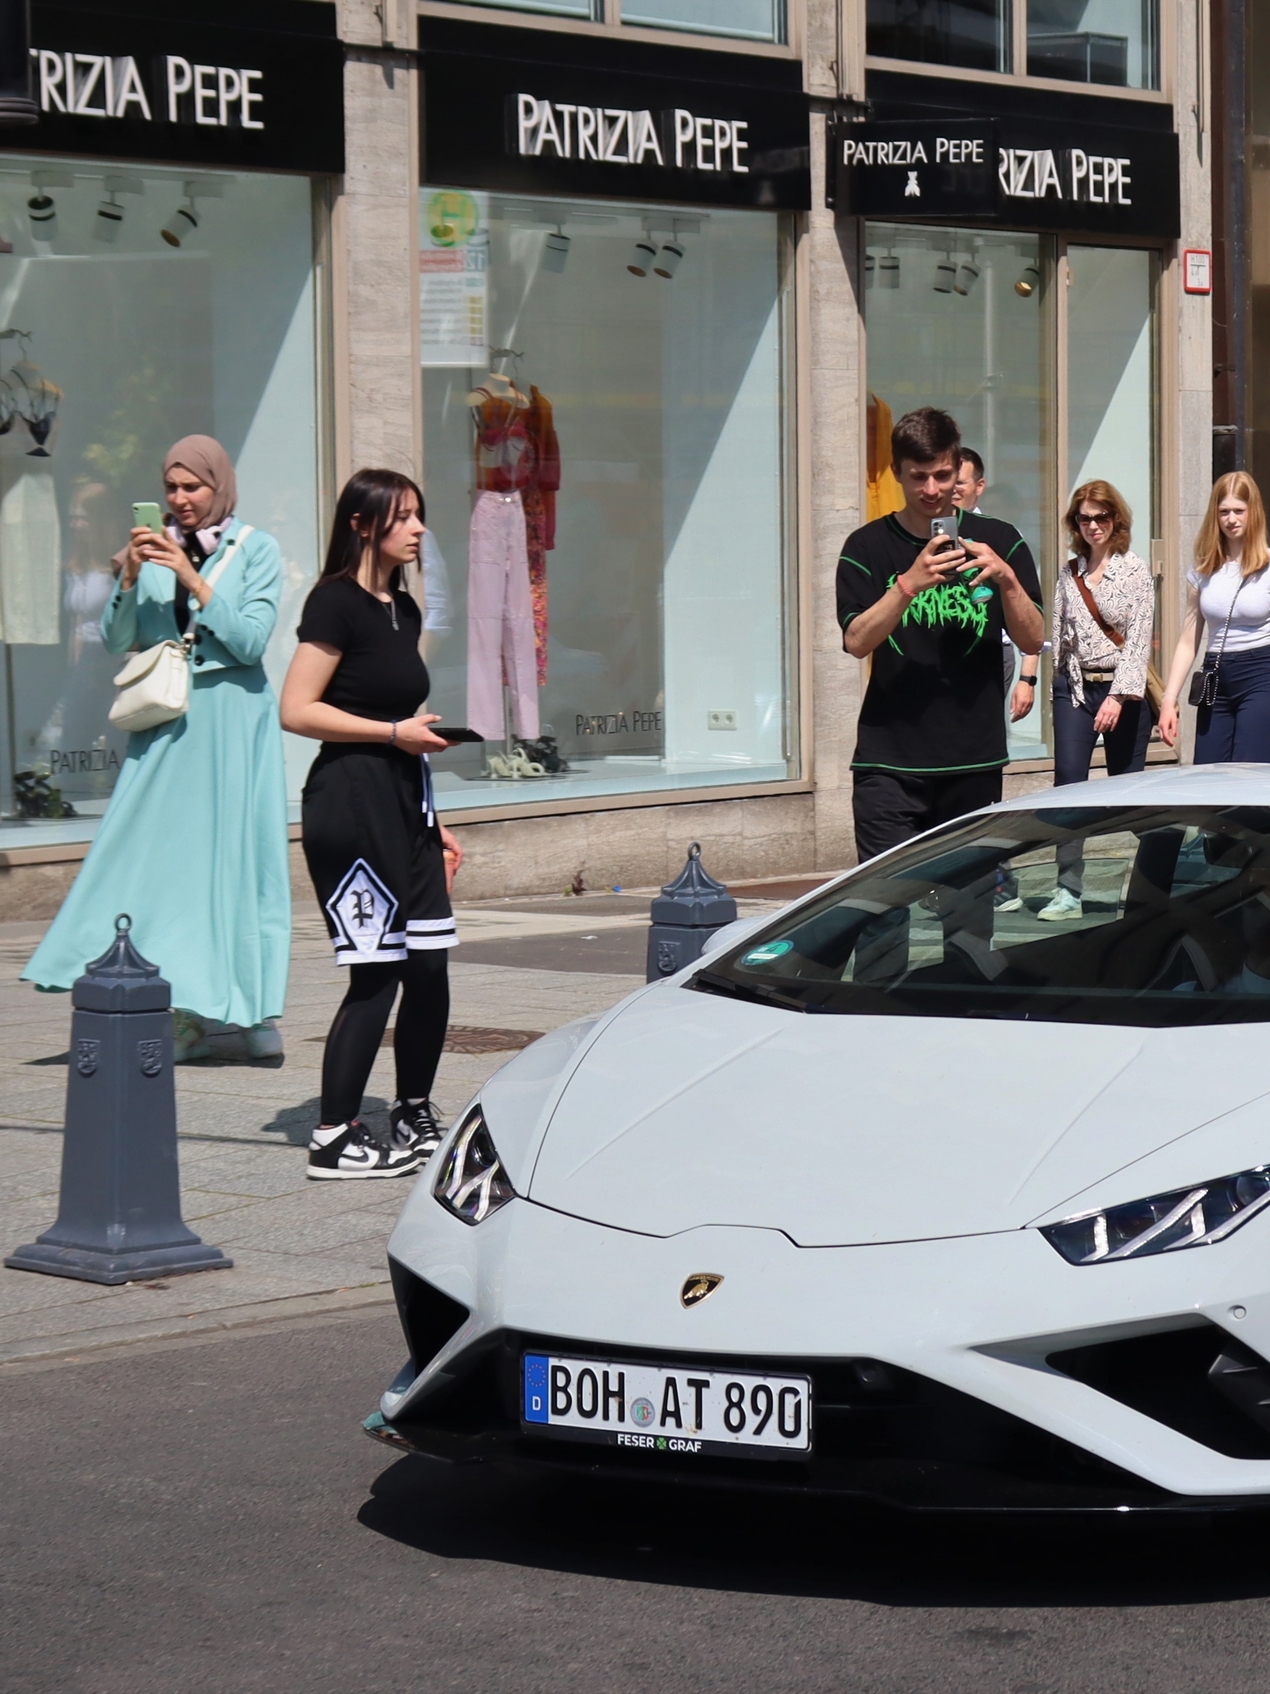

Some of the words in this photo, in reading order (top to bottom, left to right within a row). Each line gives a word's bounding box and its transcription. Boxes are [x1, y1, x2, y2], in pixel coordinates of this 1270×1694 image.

[28, 48, 152, 121] RIZIA
[167, 55, 264, 130] PEPE
[517, 93, 663, 166] PATRIZIA
[674, 108, 749, 173] PEPE
[843, 139, 927, 166] PATRIZIA
[935, 137, 984, 164] PEPE
[1071, 148, 1132, 205] PEPE
[576, 712, 628, 736] PATRIZIA
[633, 710, 662, 732] PEPE
[532, 1396, 541, 1411] D
[550, 1365, 626, 1423] BOH
[660, 1376, 711, 1430] AT
[724, 1382, 802, 1439] 890
[617, 1433, 655, 1449] FESER
[669, 1439, 702, 1453] GRAF
